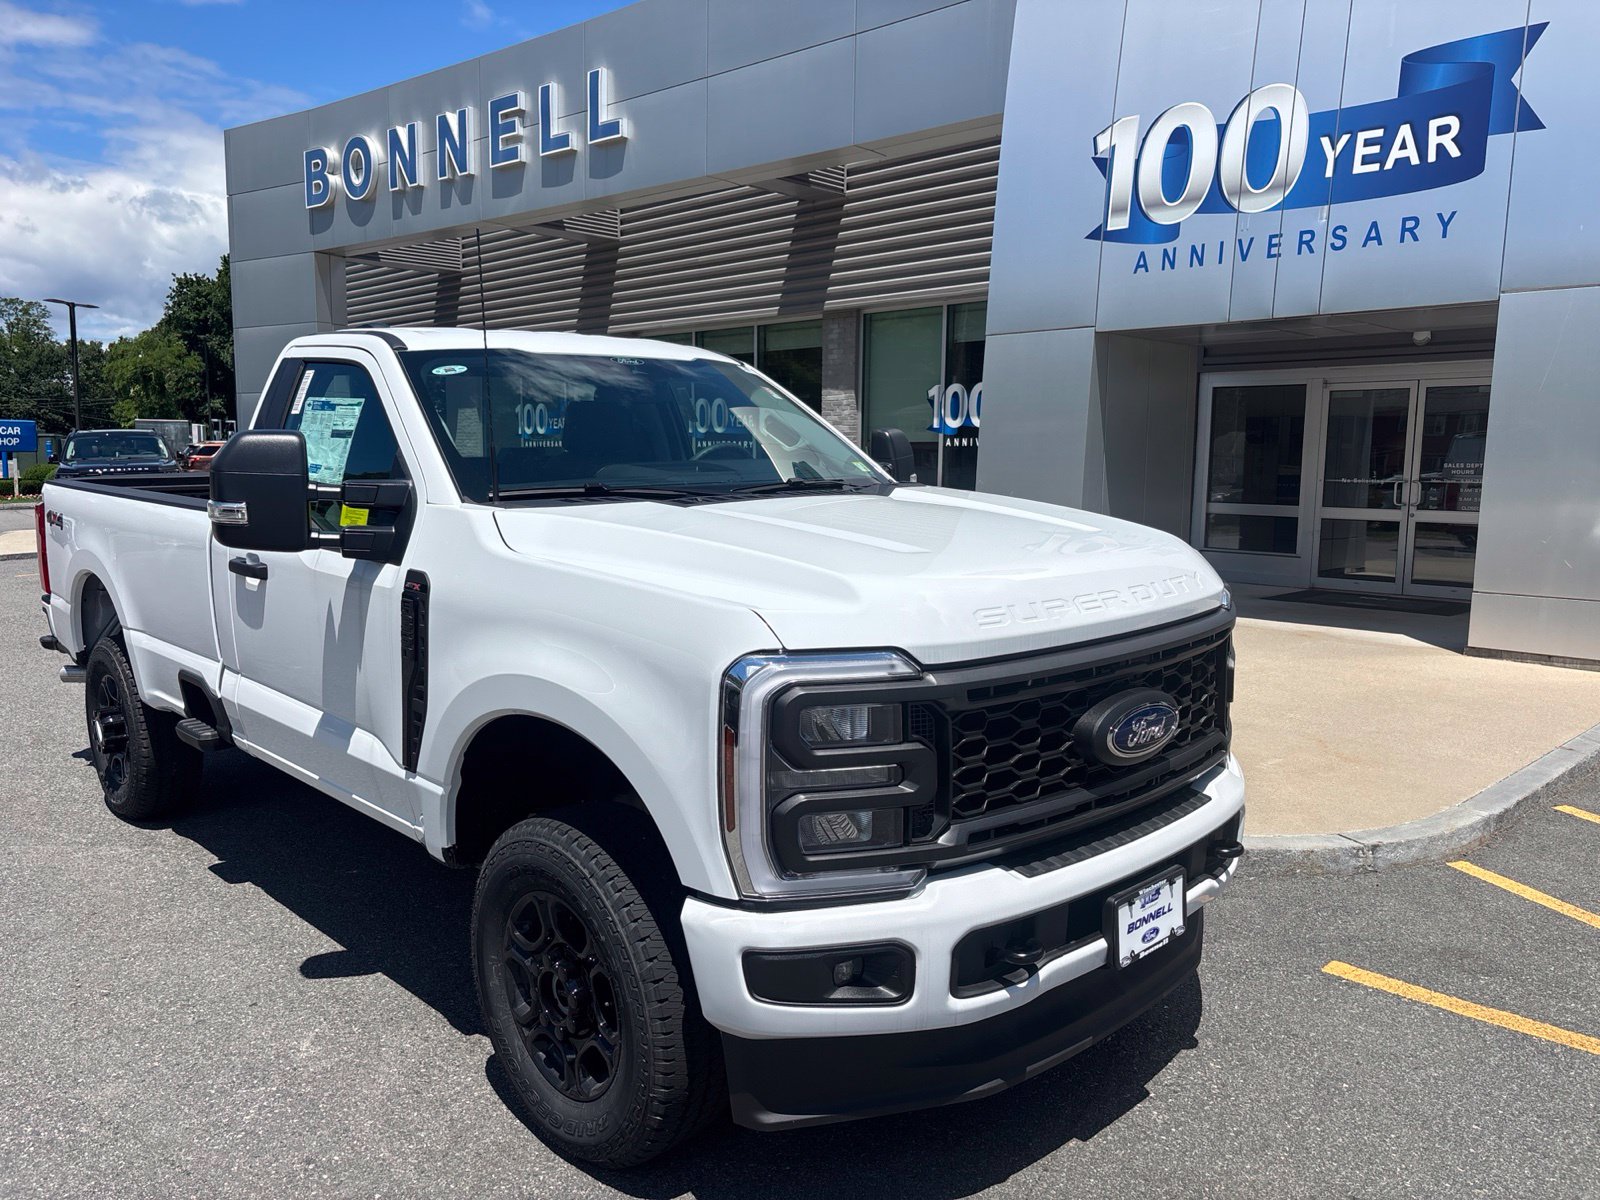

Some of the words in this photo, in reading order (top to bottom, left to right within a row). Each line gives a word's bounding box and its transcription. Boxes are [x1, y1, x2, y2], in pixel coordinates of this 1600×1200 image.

[303, 67, 629, 210] BONNELL
[1093, 82, 1310, 231] 100
[1319, 115, 1462, 178] YEAR
[1133, 210, 1459, 274] ANNIVERSARY
[0, 426, 21, 435] CAR
[514, 403, 548, 435] 100
[973, 589, 1127, 629] SUPER
[1128, 572, 1204, 602] DUTY
[1126, 711, 1167, 748] Ford
[1127, 902, 1173, 935] BONNELL
